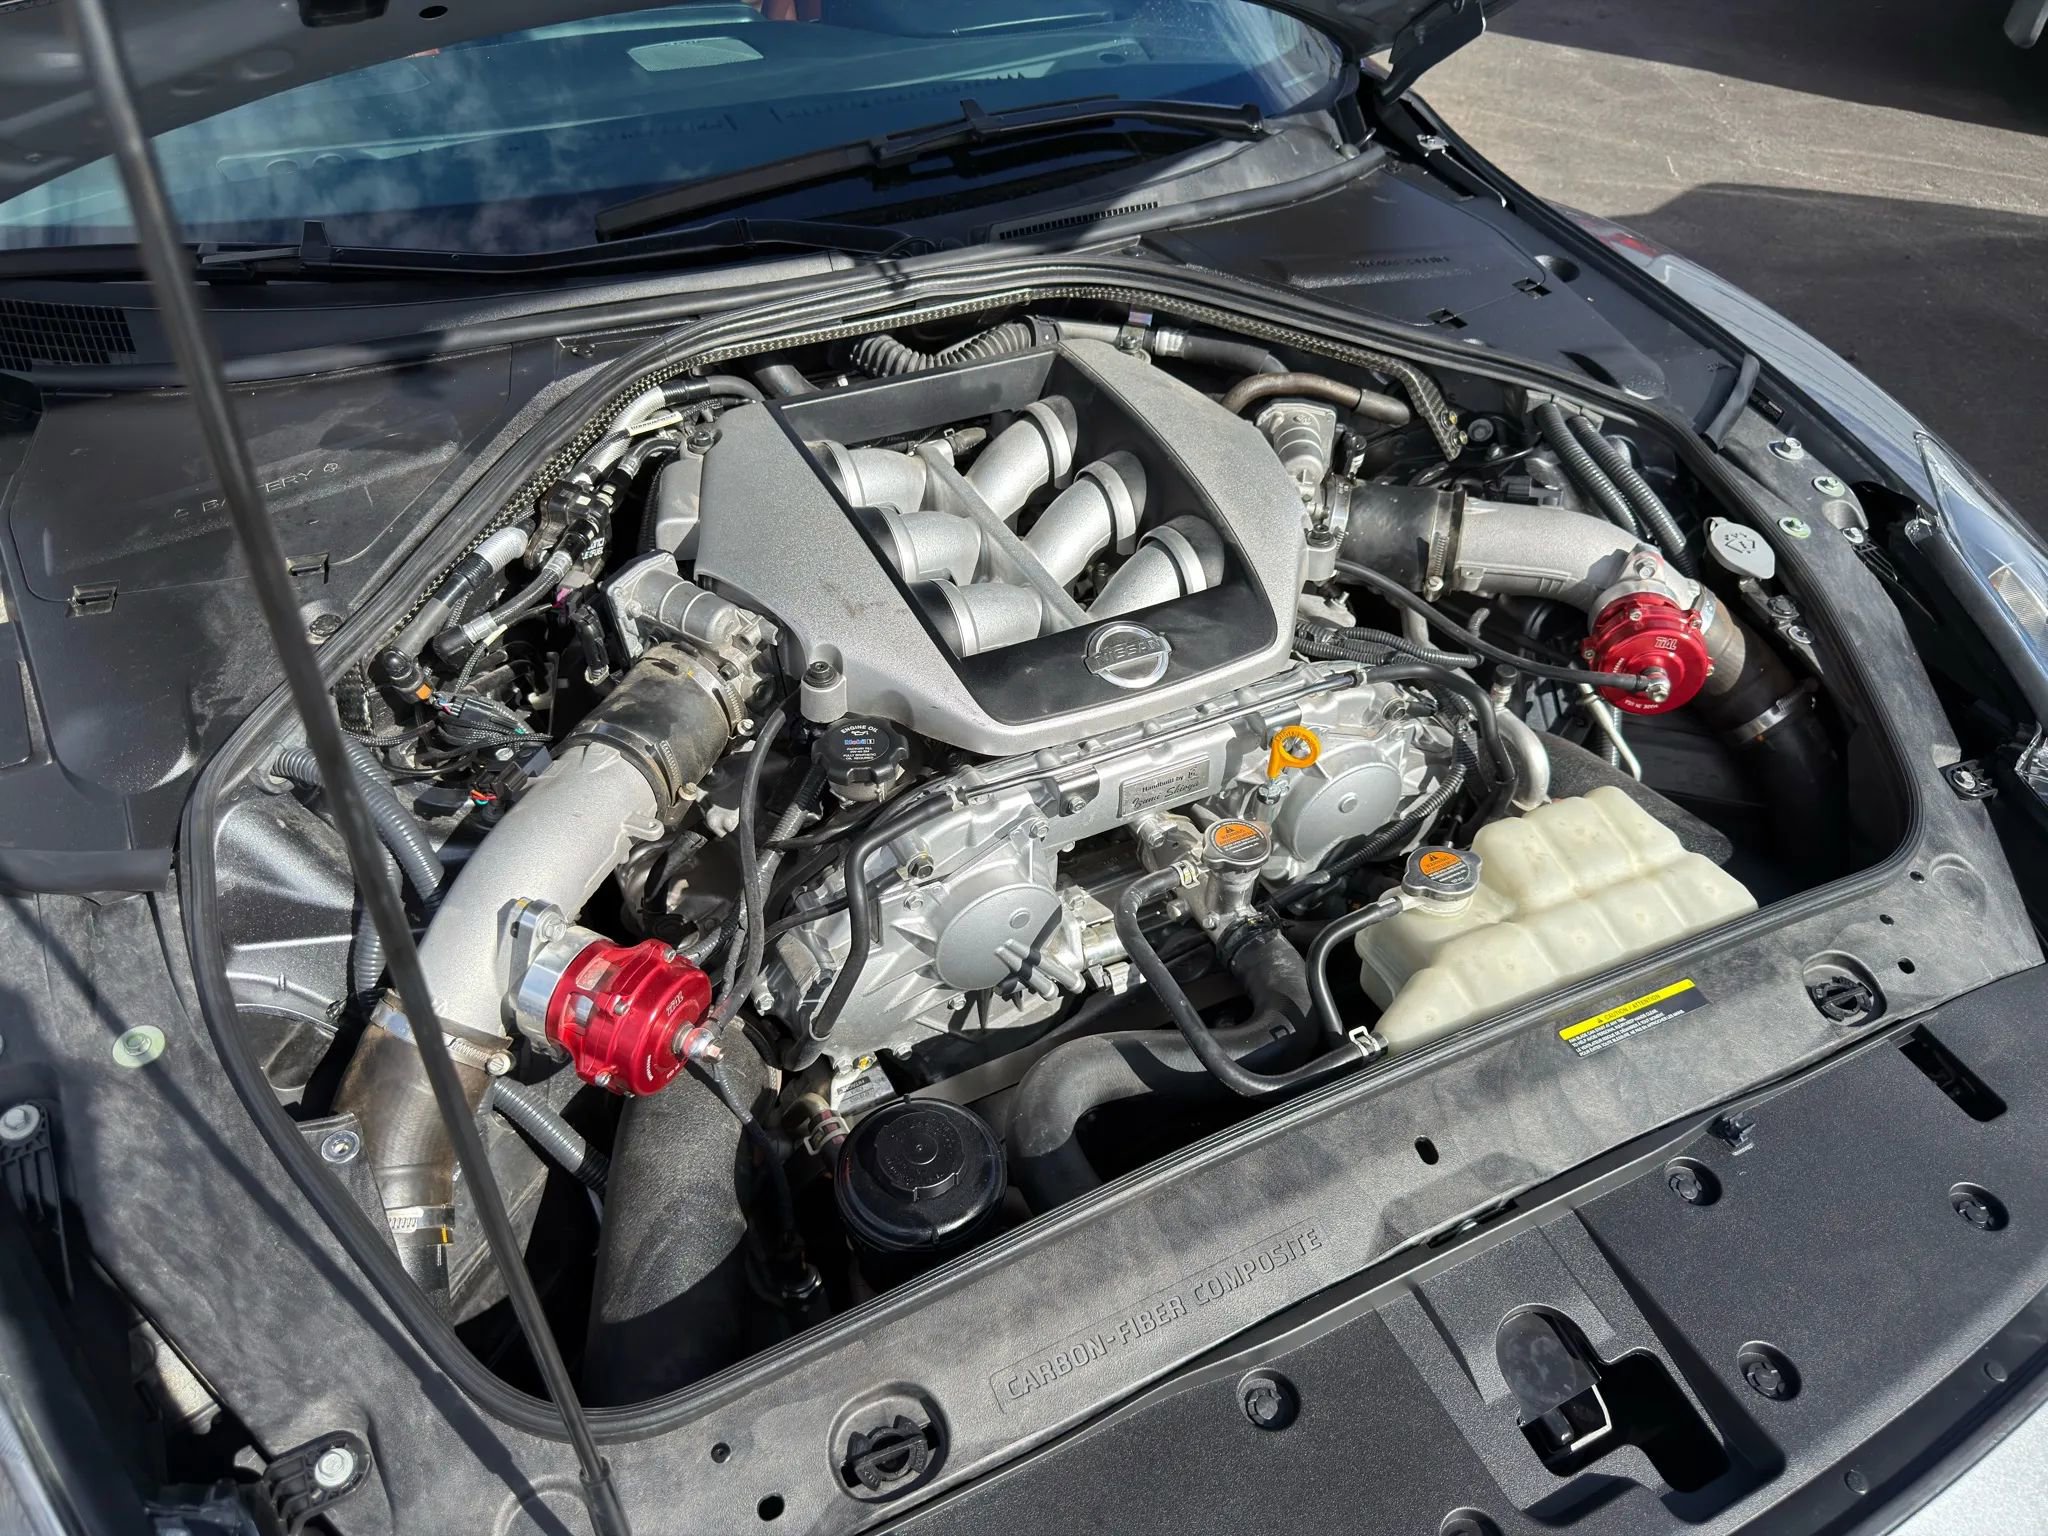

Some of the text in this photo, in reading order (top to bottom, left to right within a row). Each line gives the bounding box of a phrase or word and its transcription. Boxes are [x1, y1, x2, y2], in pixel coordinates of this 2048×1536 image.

[202, 469, 314, 512] BERY
[840, 725, 866, 734] ENGINE
[1142, 777, 1174, 793] Handbuilt
[1604, 1007, 1628, 1020] CAUTION
[1632, 994, 1661, 1009] ATTENTION
[1006, 1228, 1323, 1400] CARBON-FIBER COMPOSITE
